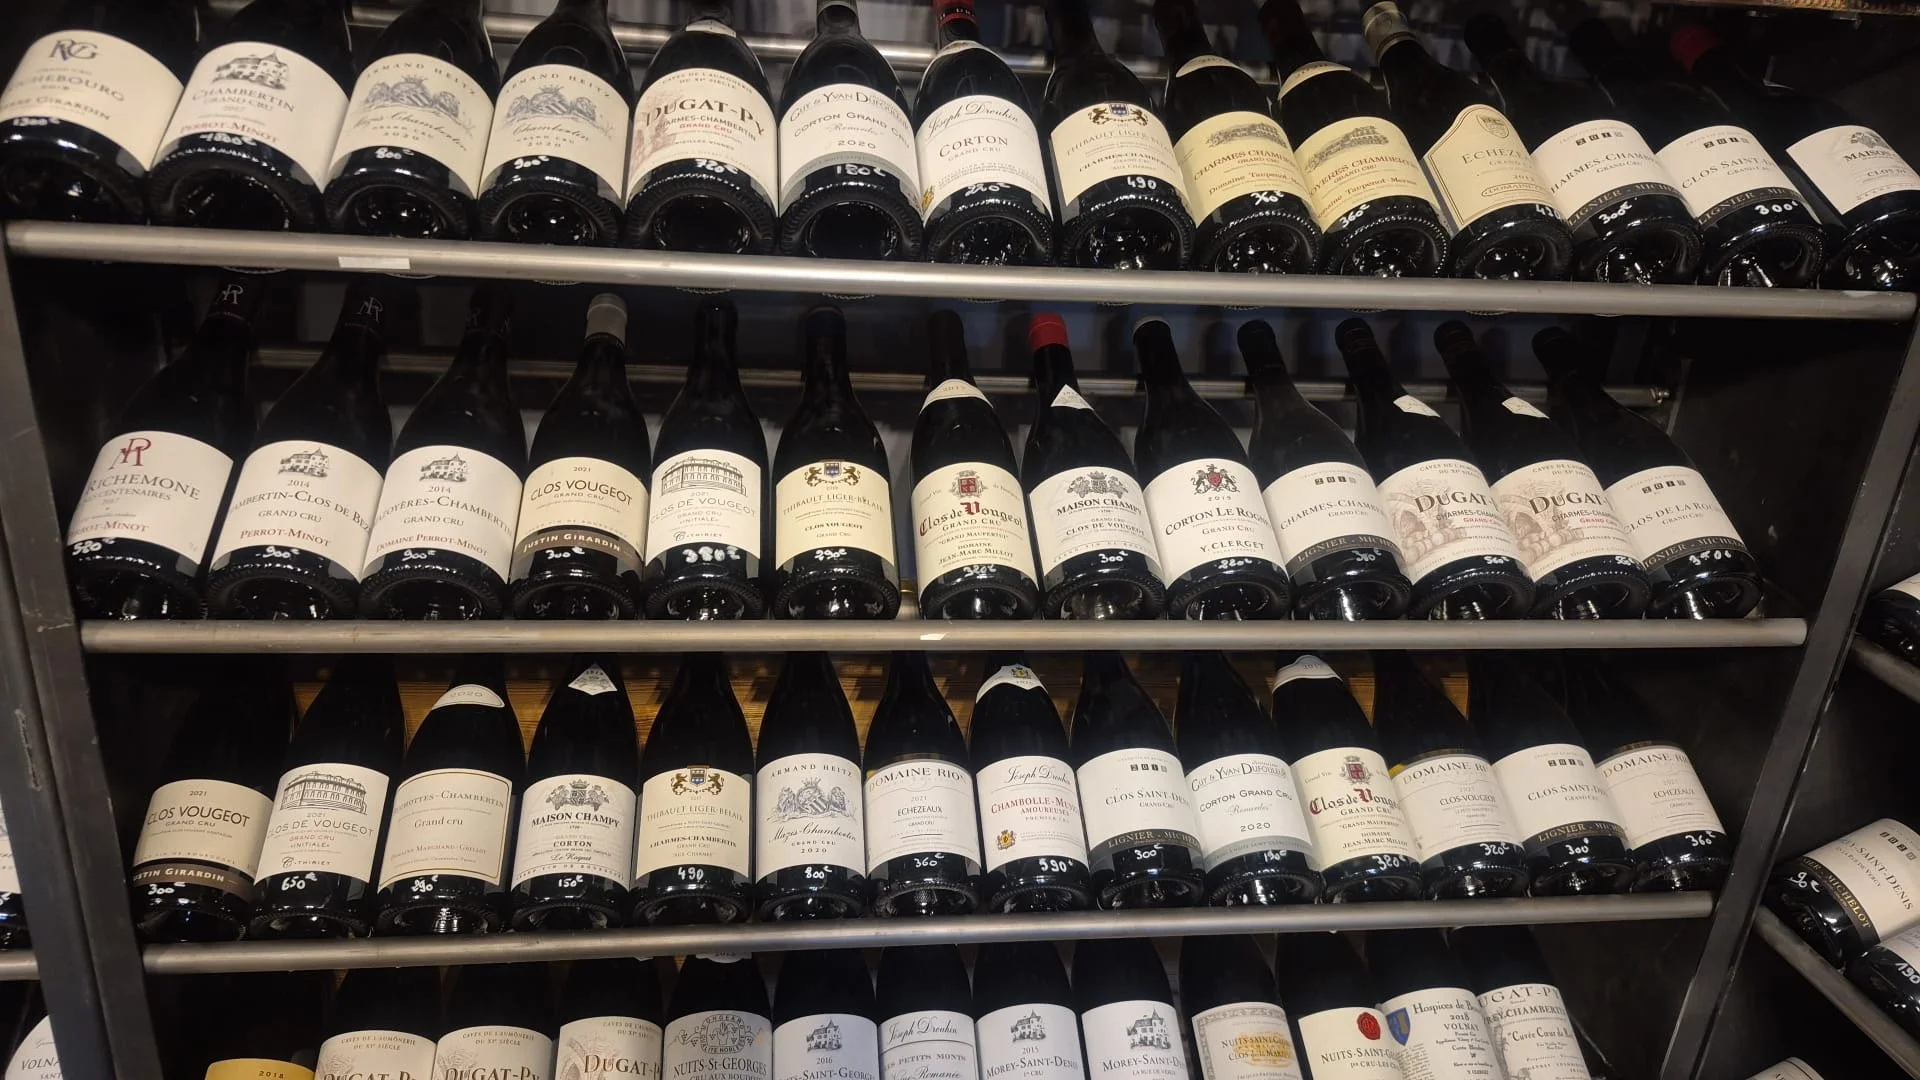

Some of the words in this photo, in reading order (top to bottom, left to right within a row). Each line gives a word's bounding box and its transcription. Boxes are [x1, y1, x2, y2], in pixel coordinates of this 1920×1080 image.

[193, 87, 297, 114] CHAMBERTIN
[646, 98, 766, 136] DUGAT-PY
[793, 113, 842, 139] CORTON
[846, 110, 888, 130] GRAND
[837, 140, 876, 152] 2020
[939, 135, 1009, 157] CORTON
[1193, 150, 1247, 181] CHARMES
[1127, 176, 1157, 190] 490
[1208, 174, 1246, 196] Domaine
[1682, 165, 1719, 189] CLOS
[1698, 192, 1755, 226] LIGNIER
[286, 479, 310, 489] 2014
[427, 485, 452, 494] 2014
[530, 481, 561, 502] CLOS
[565, 479, 633, 507] VOUGEOT
[553, 491, 584, 499] GRAND
[586, 493, 605, 501] CRU
[783, 495, 824, 514] THIBAULT
[257, 509, 297, 519] GRAND
[299, 511, 322, 523] CRU
[334, 502, 350, 518] DE
[650, 503, 674, 524] CLOS
[676, 498, 695, 508] DE
[699, 497, 757, 520] VOUGEOT
[1055, 498, 1100, 516] MAISON
[1655, 508, 1673, 519] DE
[1675, 503, 1692, 514] LA
[402, 514, 441, 525] GRAND
[443, 516, 464, 527] CRU
[804, 522, 825, 532] CLOS
[826, 520, 864, 531] VOUGEOT
[919, 514, 949, 537] Clos
[948, 509, 962, 520] de
[942, 520, 977, 532] GRAND
[980, 518, 1002, 526] CRU
[1065, 523, 1090, 536] CLOS
[1092, 522, 1105, 530] DE
[1165, 510, 1213, 536] CORTON
[1216, 507, 1233, 517] LE
[239, 527, 333, 548] PERROT-MINOT
[1201, 525, 1235, 536] GRAND
[1236, 525, 1255, 533] CRU
[375, 536, 414, 552] DOMAINE
[415, 532, 488, 557] PERROT-MINOT
[522, 535, 559, 553] JUSTIN
[563, 532, 621, 552] GIRARDIN
[957, 542, 992, 550] DOMAINE
[1211, 539, 1266, 552] CLERGET
[1297, 537, 1348, 563] LIGNIER
[938, 548, 984, 564] JEAN-MARC
[448, 690, 483, 698] 2020
[770, 763, 817, 779] ARMAND
[823, 764, 853, 777] HEITZ
[1402, 761, 1472, 786] DOMAINE
[1602, 752, 1673, 779] DOMAINE
[869, 767, 932, 792] DOMAINE
[1007, 765, 1036, 785] Joseph
[1190, 777, 1208, 794] GUY
[1215, 766, 1241, 782] YVAN
[1104, 790, 1134, 808] CLOS
[1199, 792, 1236, 814] CORTON
[1238, 788, 1273, 798] GRAND
[1275, 789, 1293, 801] CRU
[1527, 788, 1558, 802] CLOS
[646, 803, 687, 822] THIBAULT
[896, 805, 944, 818] ECHEZEAUX
[1309, 796, 1343, 816] Clos
[1342, 794, 1359, 805] de
[1339, 805, 1375, 817] GRAND
[146, 806, 174, 826] CLOS
[179, 804, 251, 828] VOUGEOT
[164, 819, 195, 827] GRAND
[413, 816, 444, 829] Grand
[446, 819, 464, 827] cru
[531, 810, 573, 827] MAISON
[574, 810, 621, 829] CHAMPY
[291, 818, 309, 829] DE
[313, 818, 375, 838] VOUGEOT
[1240, 821, 1271, 833] 2020
[1360, 830, 1392, 838] DOMAINE
[1537, 821, 1585, 843] LIGNIER
[288, 834, 316, 842] GRAND
[316, 834, 335, 842] CRU
[552, 840, 593, 849] CORTON
[1107, 830, 1154, 849] LIGNIER
[1342, 836, 1384, 850] JEAN-MARC
[800, 847, 828, 855] 2020
[164, 866, 225, 883] GIRARDIN
[677, 866, 705, 884] 490
[1827, 873, 1871, 929] MICHELOT
[1412, 1001, 1453, 1016] Hospices
[1455, 998, 1465, 1010] de
[1449, 1013, 1470, 1022] 2018
[887, 1021, 914, 1046] Joseph
[916, 1015, 958, 1036] Drouhin
[1443, 1022, 1480, 1032] VOLNAY
[1021, 1046, 1039, 1054] 2015
[673, 1056, 768, 1078] NUITS-St-GEORGES
[816, 1056, 833, 1065] 2016
[898, 1053, 932, 1067] PETITS
[935, 1052, 967, 1062] MONTS
[258, 1070, 285, 1079] 2018
